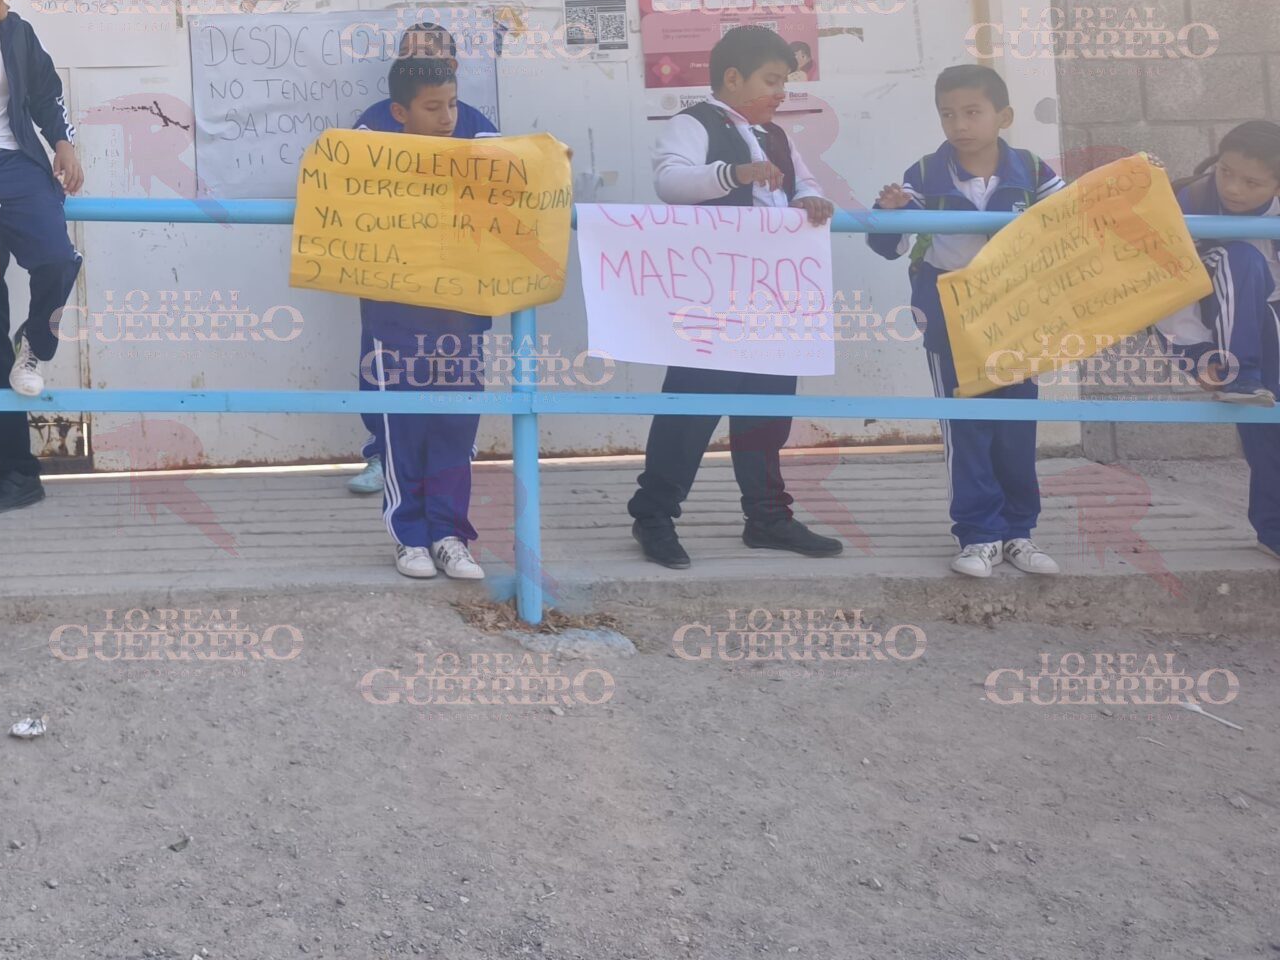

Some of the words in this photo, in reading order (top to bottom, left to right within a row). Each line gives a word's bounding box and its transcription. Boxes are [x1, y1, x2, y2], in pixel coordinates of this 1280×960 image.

[201, 24, 310, 69] DESDE
[209, 79, 244, 100] NO
[252, 77, 369, 101] TENEMOS
[314, 137, 350, 166] NO
[367, 143, 529, 186] VIOLENTEN
[302, 167, 327, 191] MI
[345, 176, 449, 198] DERECHO
[460, 185, 475, 200] A
[314, 205, 343, 229] YA
[355, 211, 439, 233] QUIERO
[452, 213, 475, 232] IR
[489, 216, 502, 235] A
[515, 218, 540, 237] LA
[339, 266, 421, 293] MESES
[434, 276, 463, 297] ES
[600, 246, 825, 316] MAESTROS
